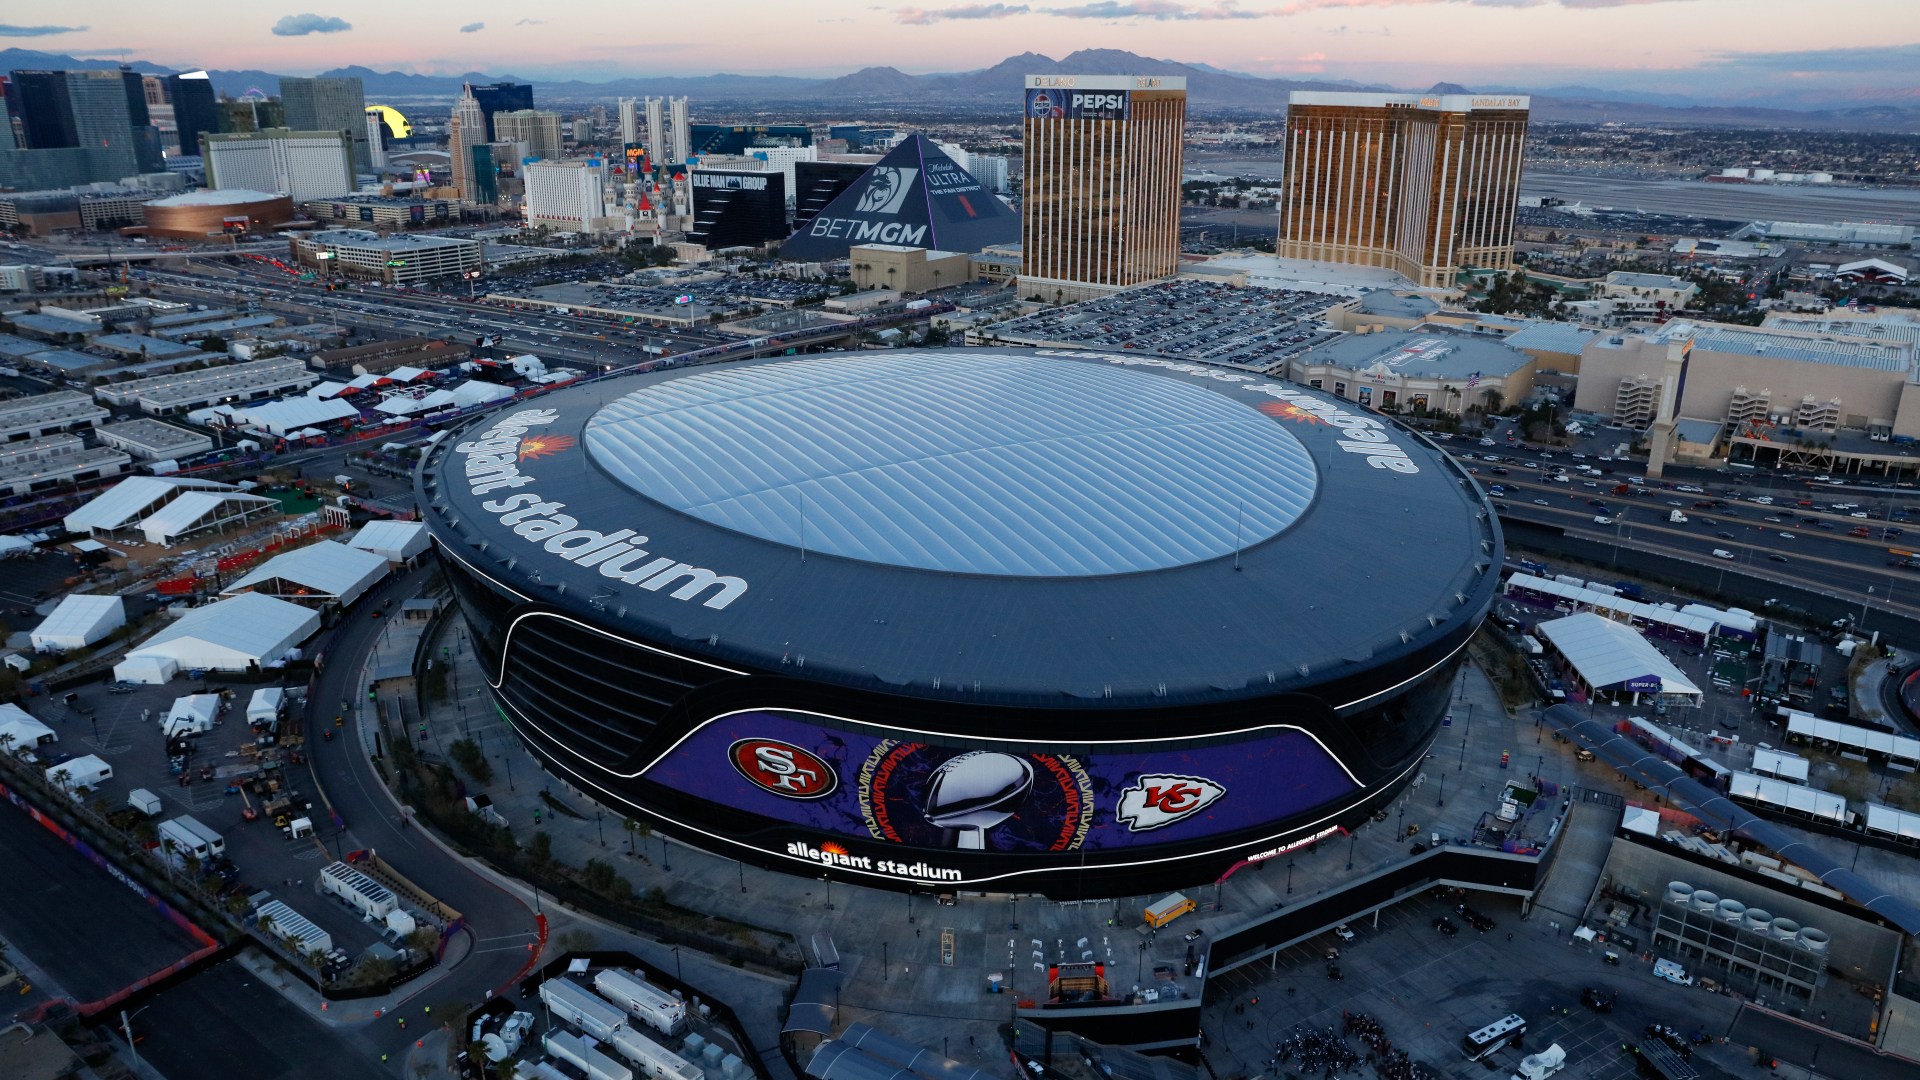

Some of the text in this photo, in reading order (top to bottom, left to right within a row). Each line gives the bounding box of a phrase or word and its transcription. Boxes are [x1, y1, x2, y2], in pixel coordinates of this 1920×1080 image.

[1034, 77, 1076, 88] DELANO
[1072, 94, 1123, 110] PEPSI
[626, 148, 644, 157] MGM
[692, 174, 767, 190] BLUE MAN GROUP
[926, 171, 970, 187] ULTRA
[955, 185, 981, 193] DISTRICT
[810, 217, 927, 245] BETMGM
[1241, 383, 1420, 475] allegiant
[455, 408, 748, 610] allegiant stadium
[755, 746, 817, 791] SF
[1142, 783, 1202, 813] KC
[1247, 824, 1338, 862] WELCOME TO ALLEGIANT STADIUM
[787, 841, 962, 881] allegiant stadium
